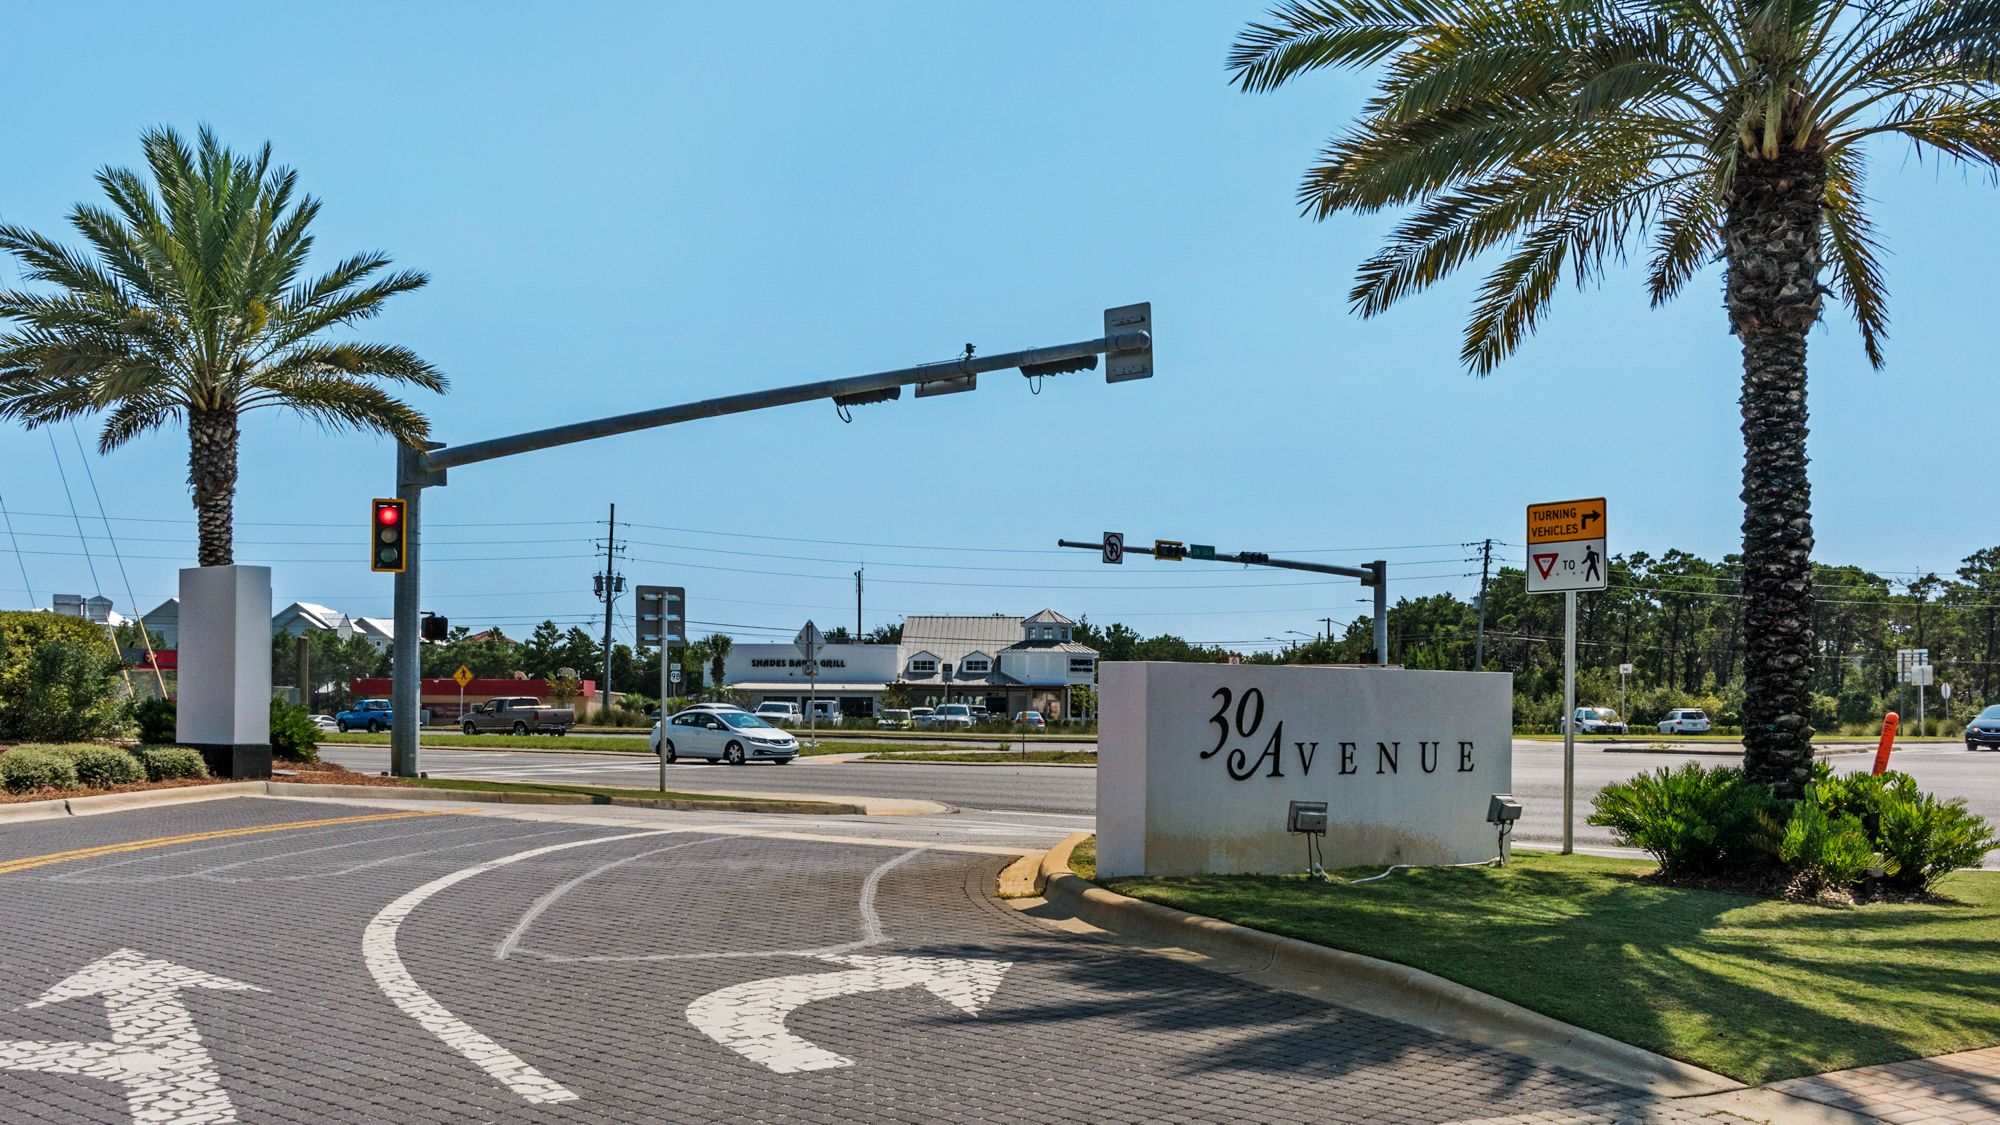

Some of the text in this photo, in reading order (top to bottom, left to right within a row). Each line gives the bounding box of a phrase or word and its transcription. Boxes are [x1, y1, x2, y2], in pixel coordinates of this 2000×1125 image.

[1533, 508, 1577, 521] TURNING
[1531, 524, 1578, 537] VEHICLES
[1562, 560, 1575, 571] TO
[751, 659, 786, 668] SHADES
[820, 659, 845, 668] GRILL
[672, 673, 680, 681] 98
[1200, 687, 1264, 760] 30
[1227, 720, 1475, 781] AVENUE
